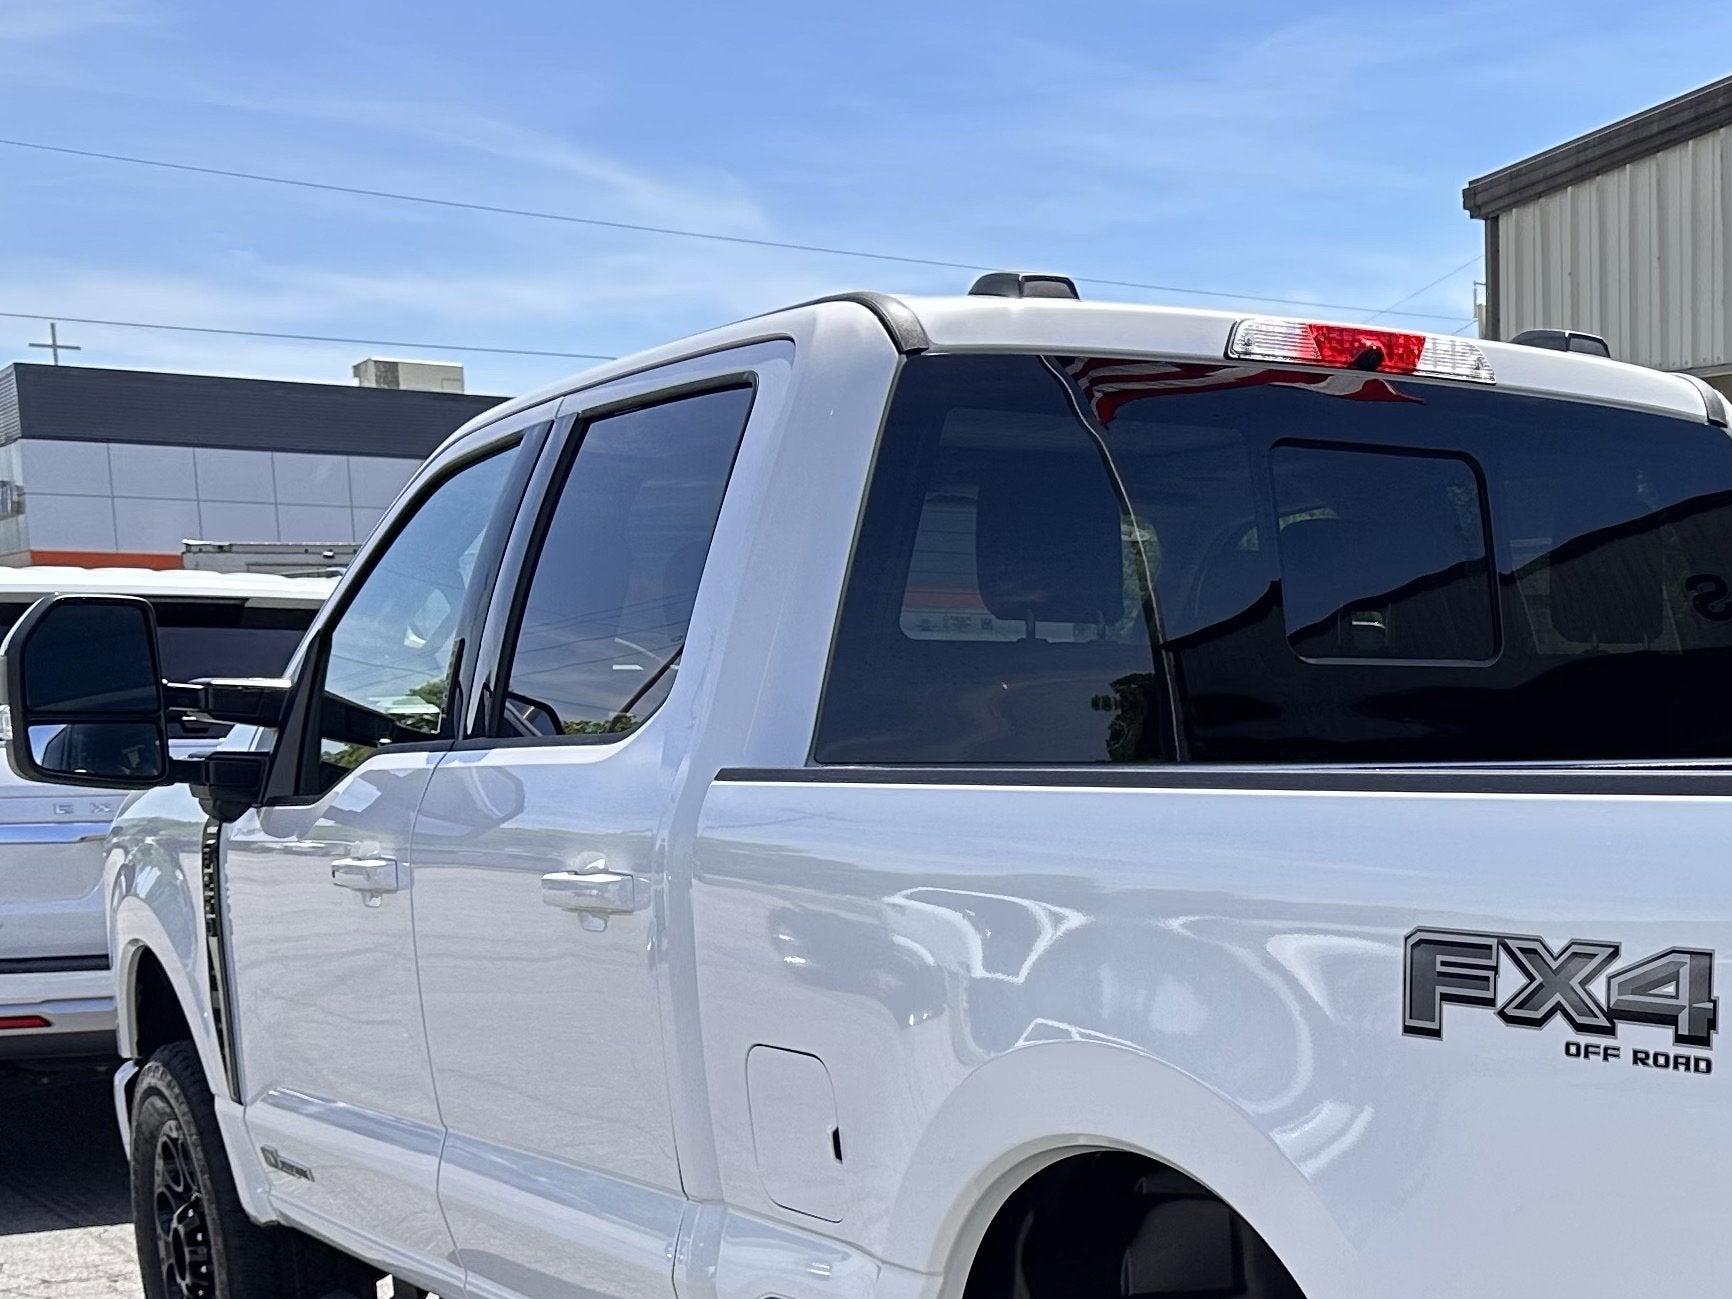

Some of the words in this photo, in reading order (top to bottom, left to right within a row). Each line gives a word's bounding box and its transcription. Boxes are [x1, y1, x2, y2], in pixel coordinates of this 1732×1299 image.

[1402, 926, 1719, 1050] FX4
[1565, 1041, 1621, 1062] OFF
[1632, 1049, 1713, 1075] ROAD
